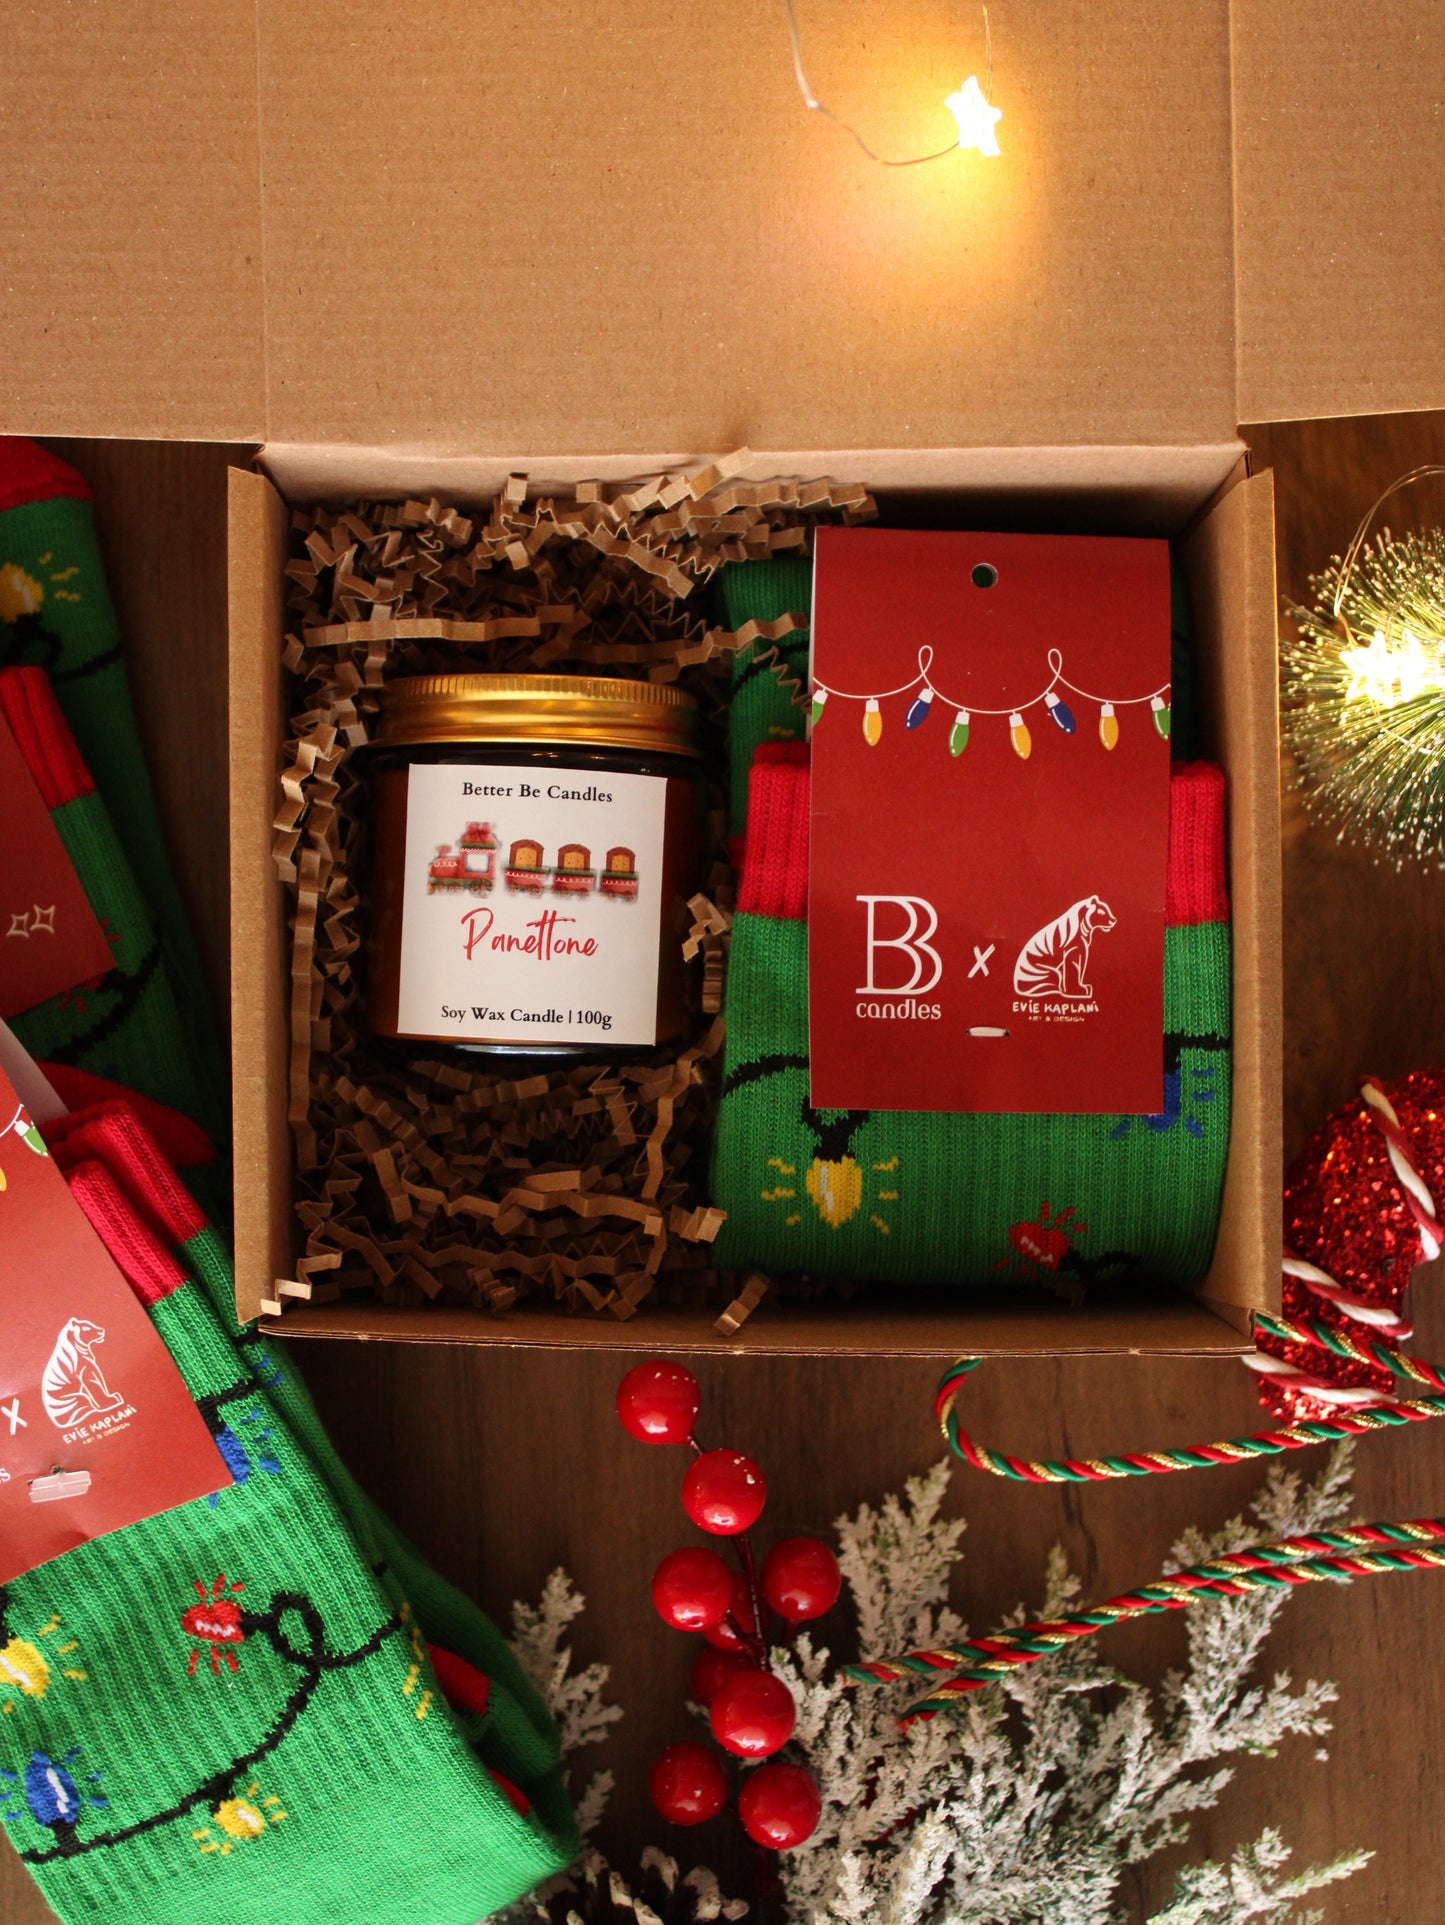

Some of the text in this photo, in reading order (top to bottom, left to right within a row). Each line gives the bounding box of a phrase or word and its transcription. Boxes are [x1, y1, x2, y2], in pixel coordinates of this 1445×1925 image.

[462, 782, 613, 803] Better Be Candles
[460, 907, 599, 961] Panettone
[441, 1006, 466, 1024] Soy
[471, 1006, 505, 1021] Wax
[510, 1008, 564, 1024] Candle
[576, 1010, 613, 1030] 100g
[855, 999, 942, 1020] candles
